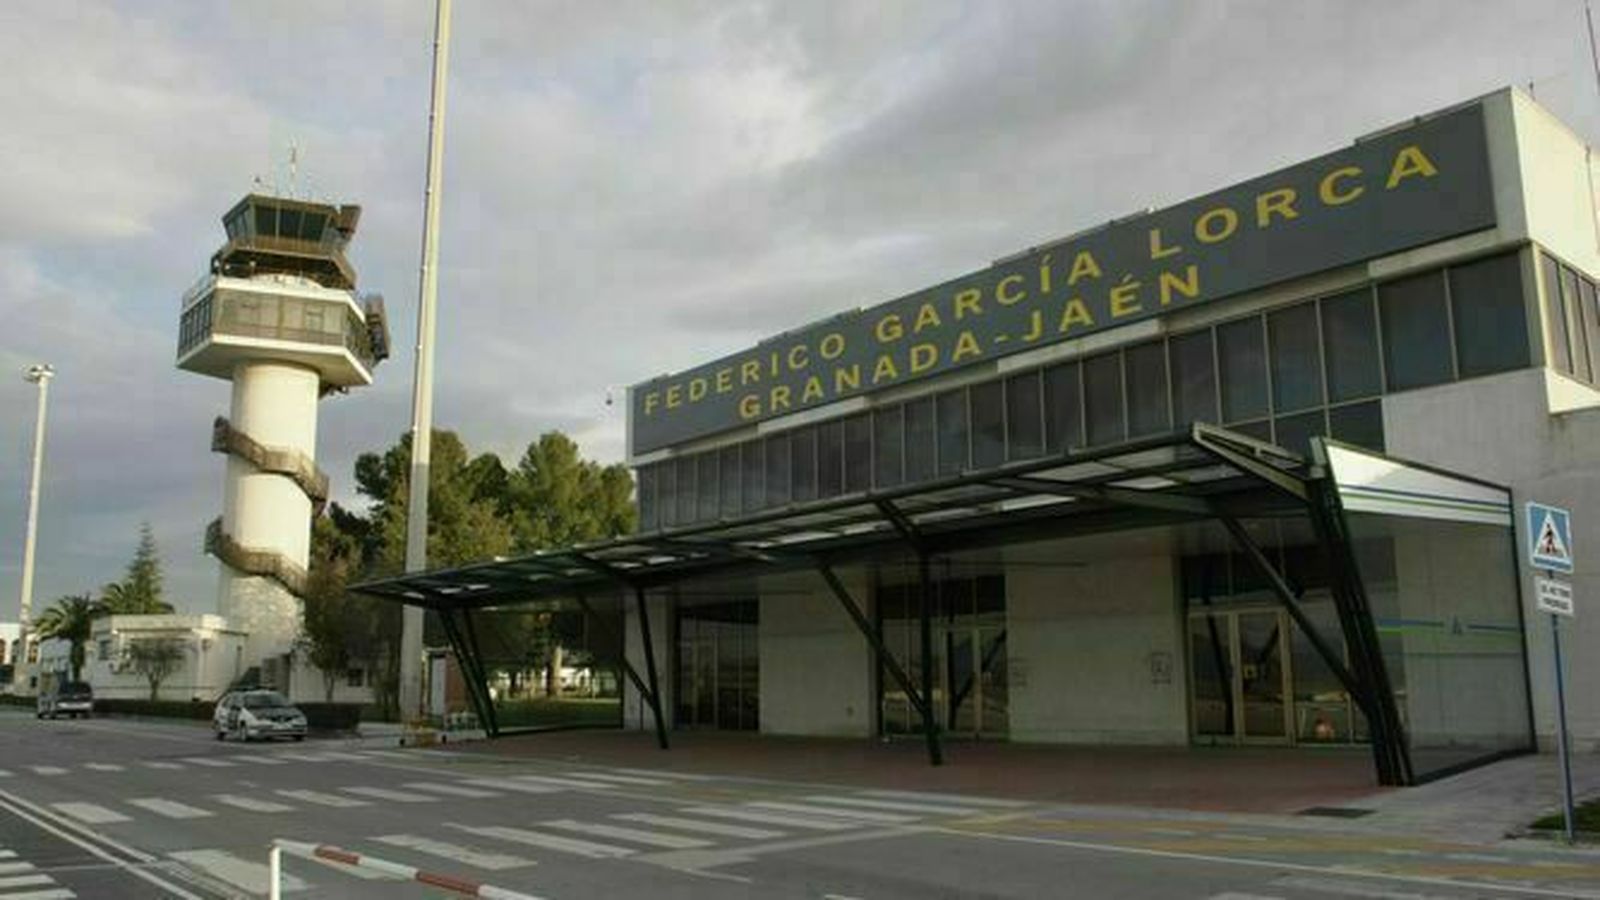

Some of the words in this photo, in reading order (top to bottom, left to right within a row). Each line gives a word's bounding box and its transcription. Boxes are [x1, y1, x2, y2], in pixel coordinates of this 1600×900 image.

[643, 332, 846, 416] FEDERICO
[875, 250, 1101, 342] GARCÍA
[1149, 144, 1438, 258] LORCA
[739, 265, 1201, 418] GRANADA-JAÉN
